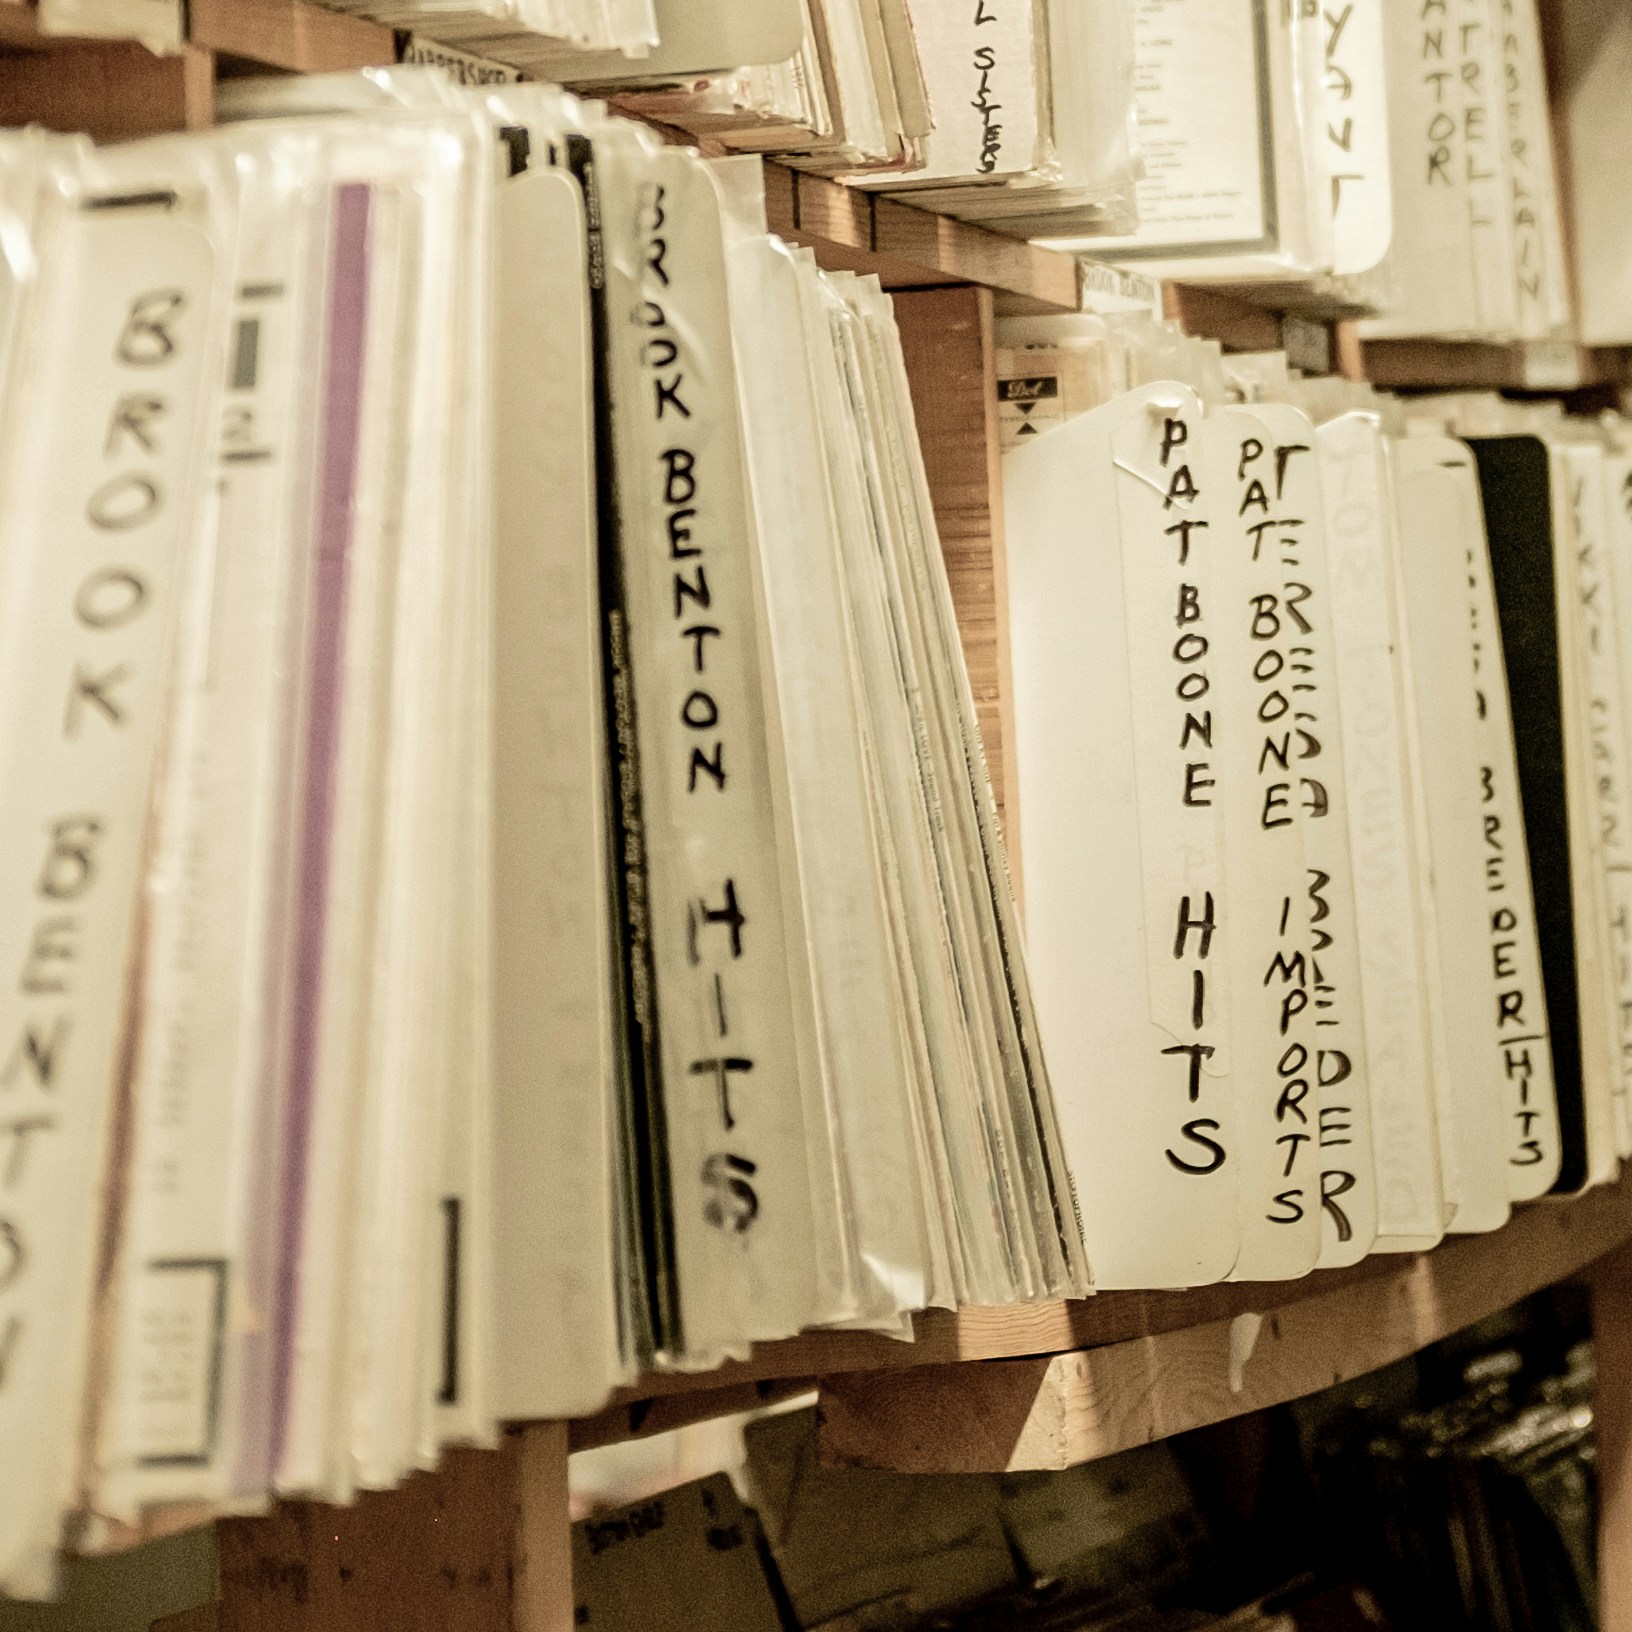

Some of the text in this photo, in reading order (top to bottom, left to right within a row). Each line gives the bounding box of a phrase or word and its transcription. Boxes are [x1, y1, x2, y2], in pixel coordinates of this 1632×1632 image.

[61, 286, 188, 744] BROOK
[628, 183, 760, 1236] BROOK BENTON HITS
[1160, 418, 1227, 1176] PAT BOONE HITS
[1237, 438, 1311, 1225] PAT BOONE IMPORTS
[1503, 1045, 1546, 1168] HITS
